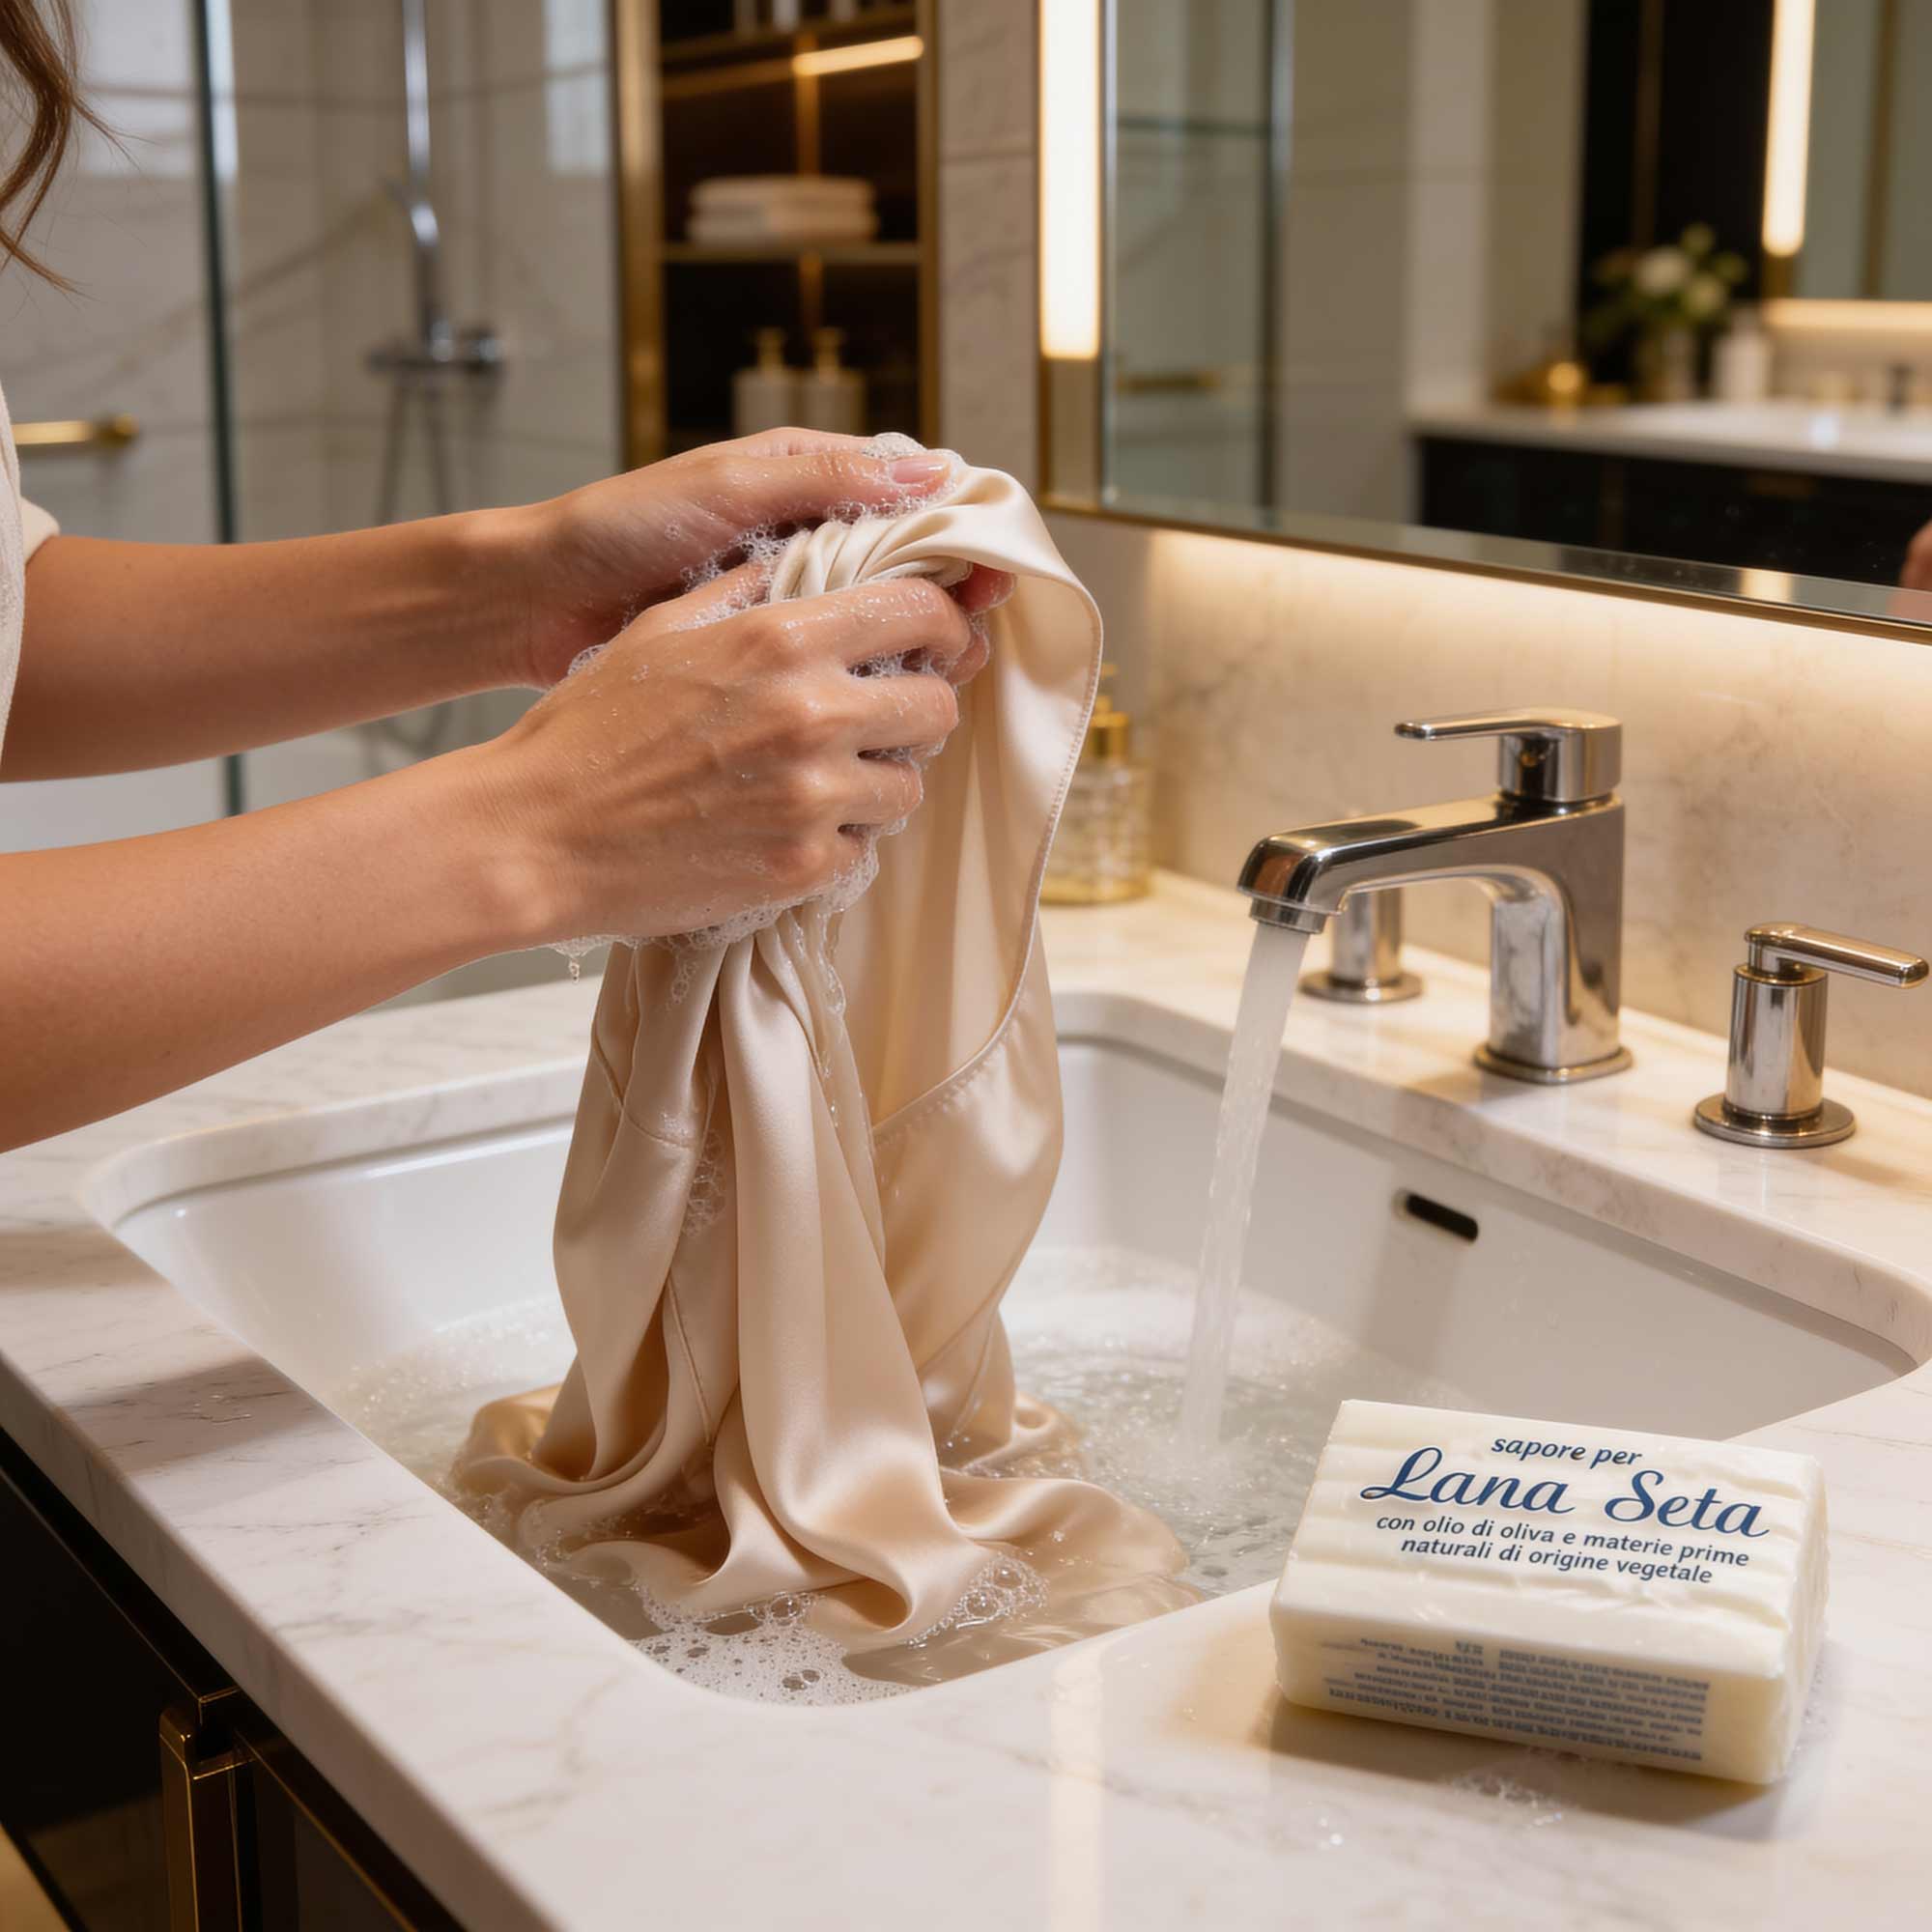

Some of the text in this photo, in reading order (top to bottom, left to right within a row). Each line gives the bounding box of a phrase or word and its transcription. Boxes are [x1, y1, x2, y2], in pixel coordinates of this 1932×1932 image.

[1491, 1435, 1642, 1469] sapore per
[1359, 1445, 1770, 1539] Lana Seta
[1376, 1515, 1750, 1568] con olio di oliva e materie prime
[1401, 1537, 1713, 1584] naturali di origine vegetale
